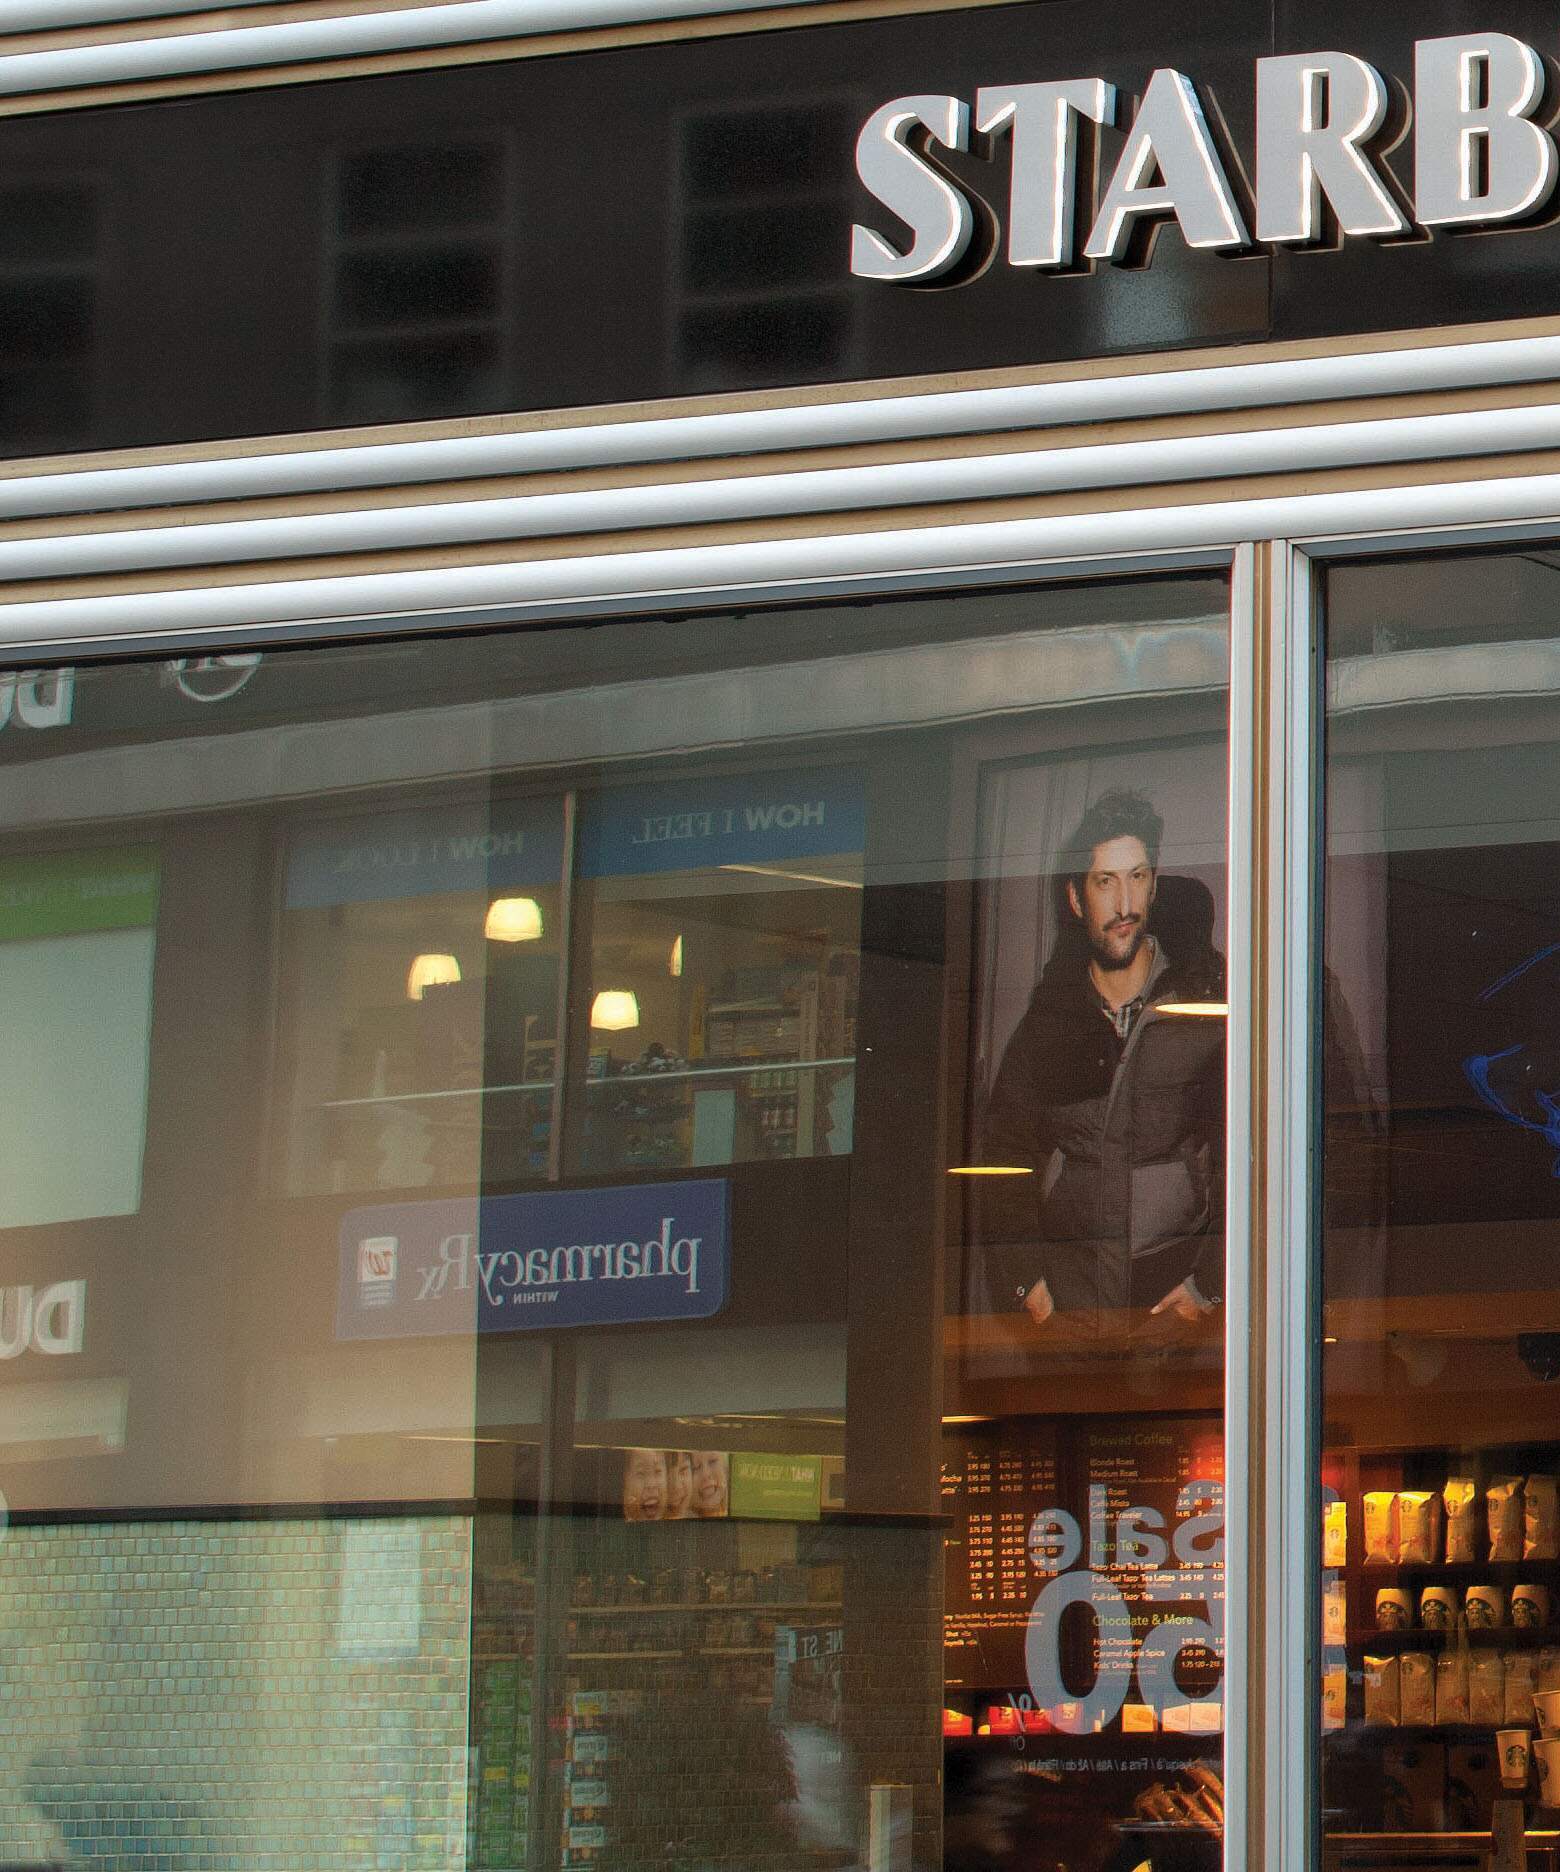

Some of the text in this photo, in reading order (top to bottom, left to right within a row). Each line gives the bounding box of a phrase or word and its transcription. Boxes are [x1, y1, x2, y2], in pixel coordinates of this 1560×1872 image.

[1089, 1432, 1174, 1446] Brewed Coffee
[1091, 1614, 1194, 1626] Chocolate & More
[1093, 1638, 1142, 1646] Hot Chocolate
[1123, 1649, 1145, 1658] Apple
[1146, 1648, 1166, 1657] Spice
